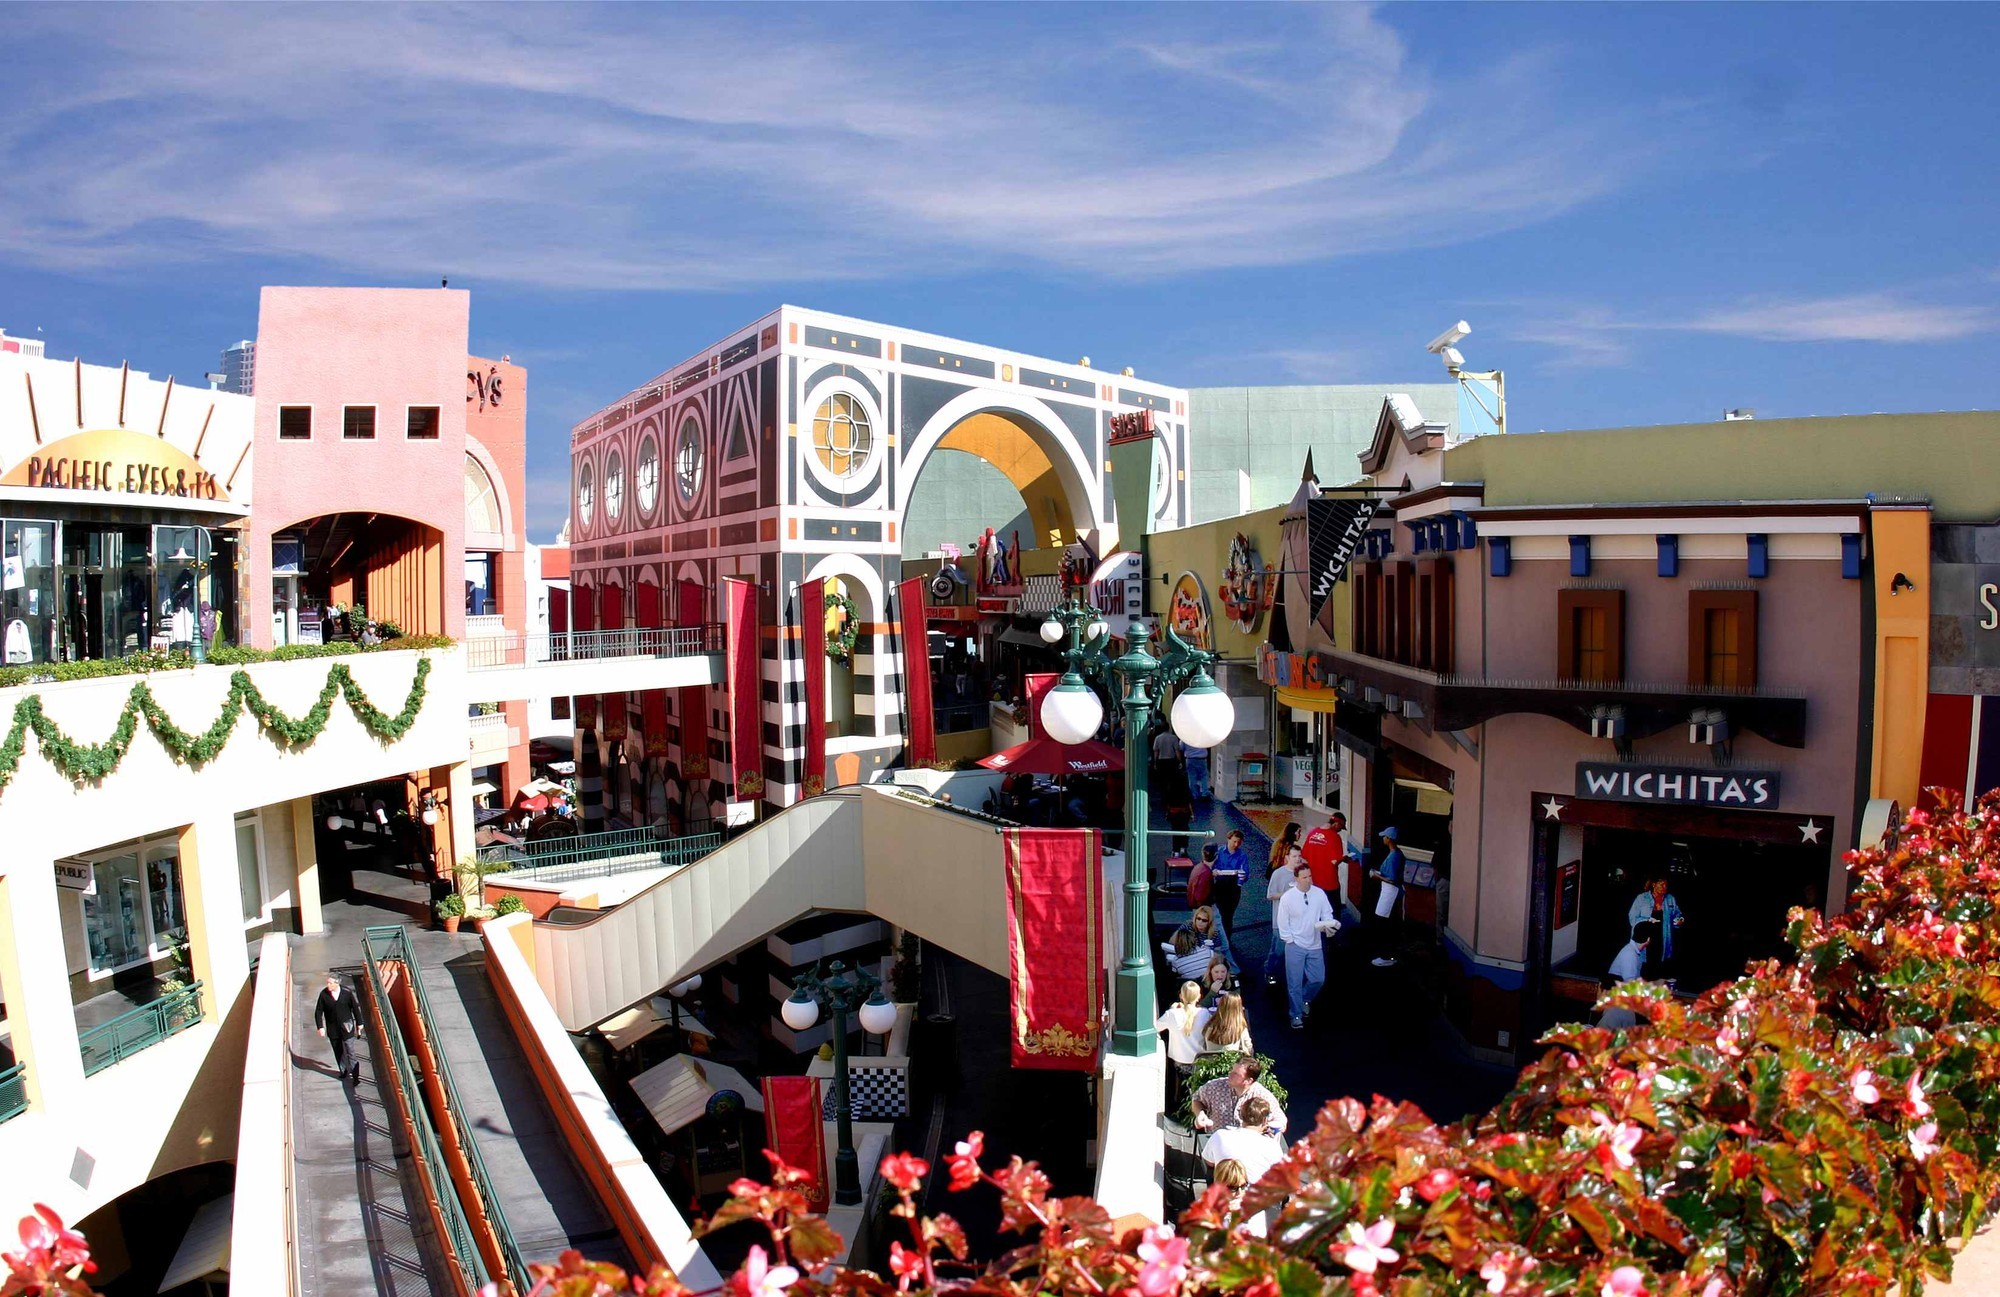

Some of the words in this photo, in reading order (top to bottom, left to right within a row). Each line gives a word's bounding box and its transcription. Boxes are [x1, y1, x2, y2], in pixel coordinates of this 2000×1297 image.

[1109, 409, 1155, 439] SUSHI
[28, 456, 112, 491] PACIFIC
[126, 463, 169, 495] EYES
[1312, 503, 1373, 596] WICHITA'S
[1094, 579, 1124, 616] SUSHI
[1067, 760, 1107, 770] Westfield
[1585, 769, 1768, 804] WICHITA'S
